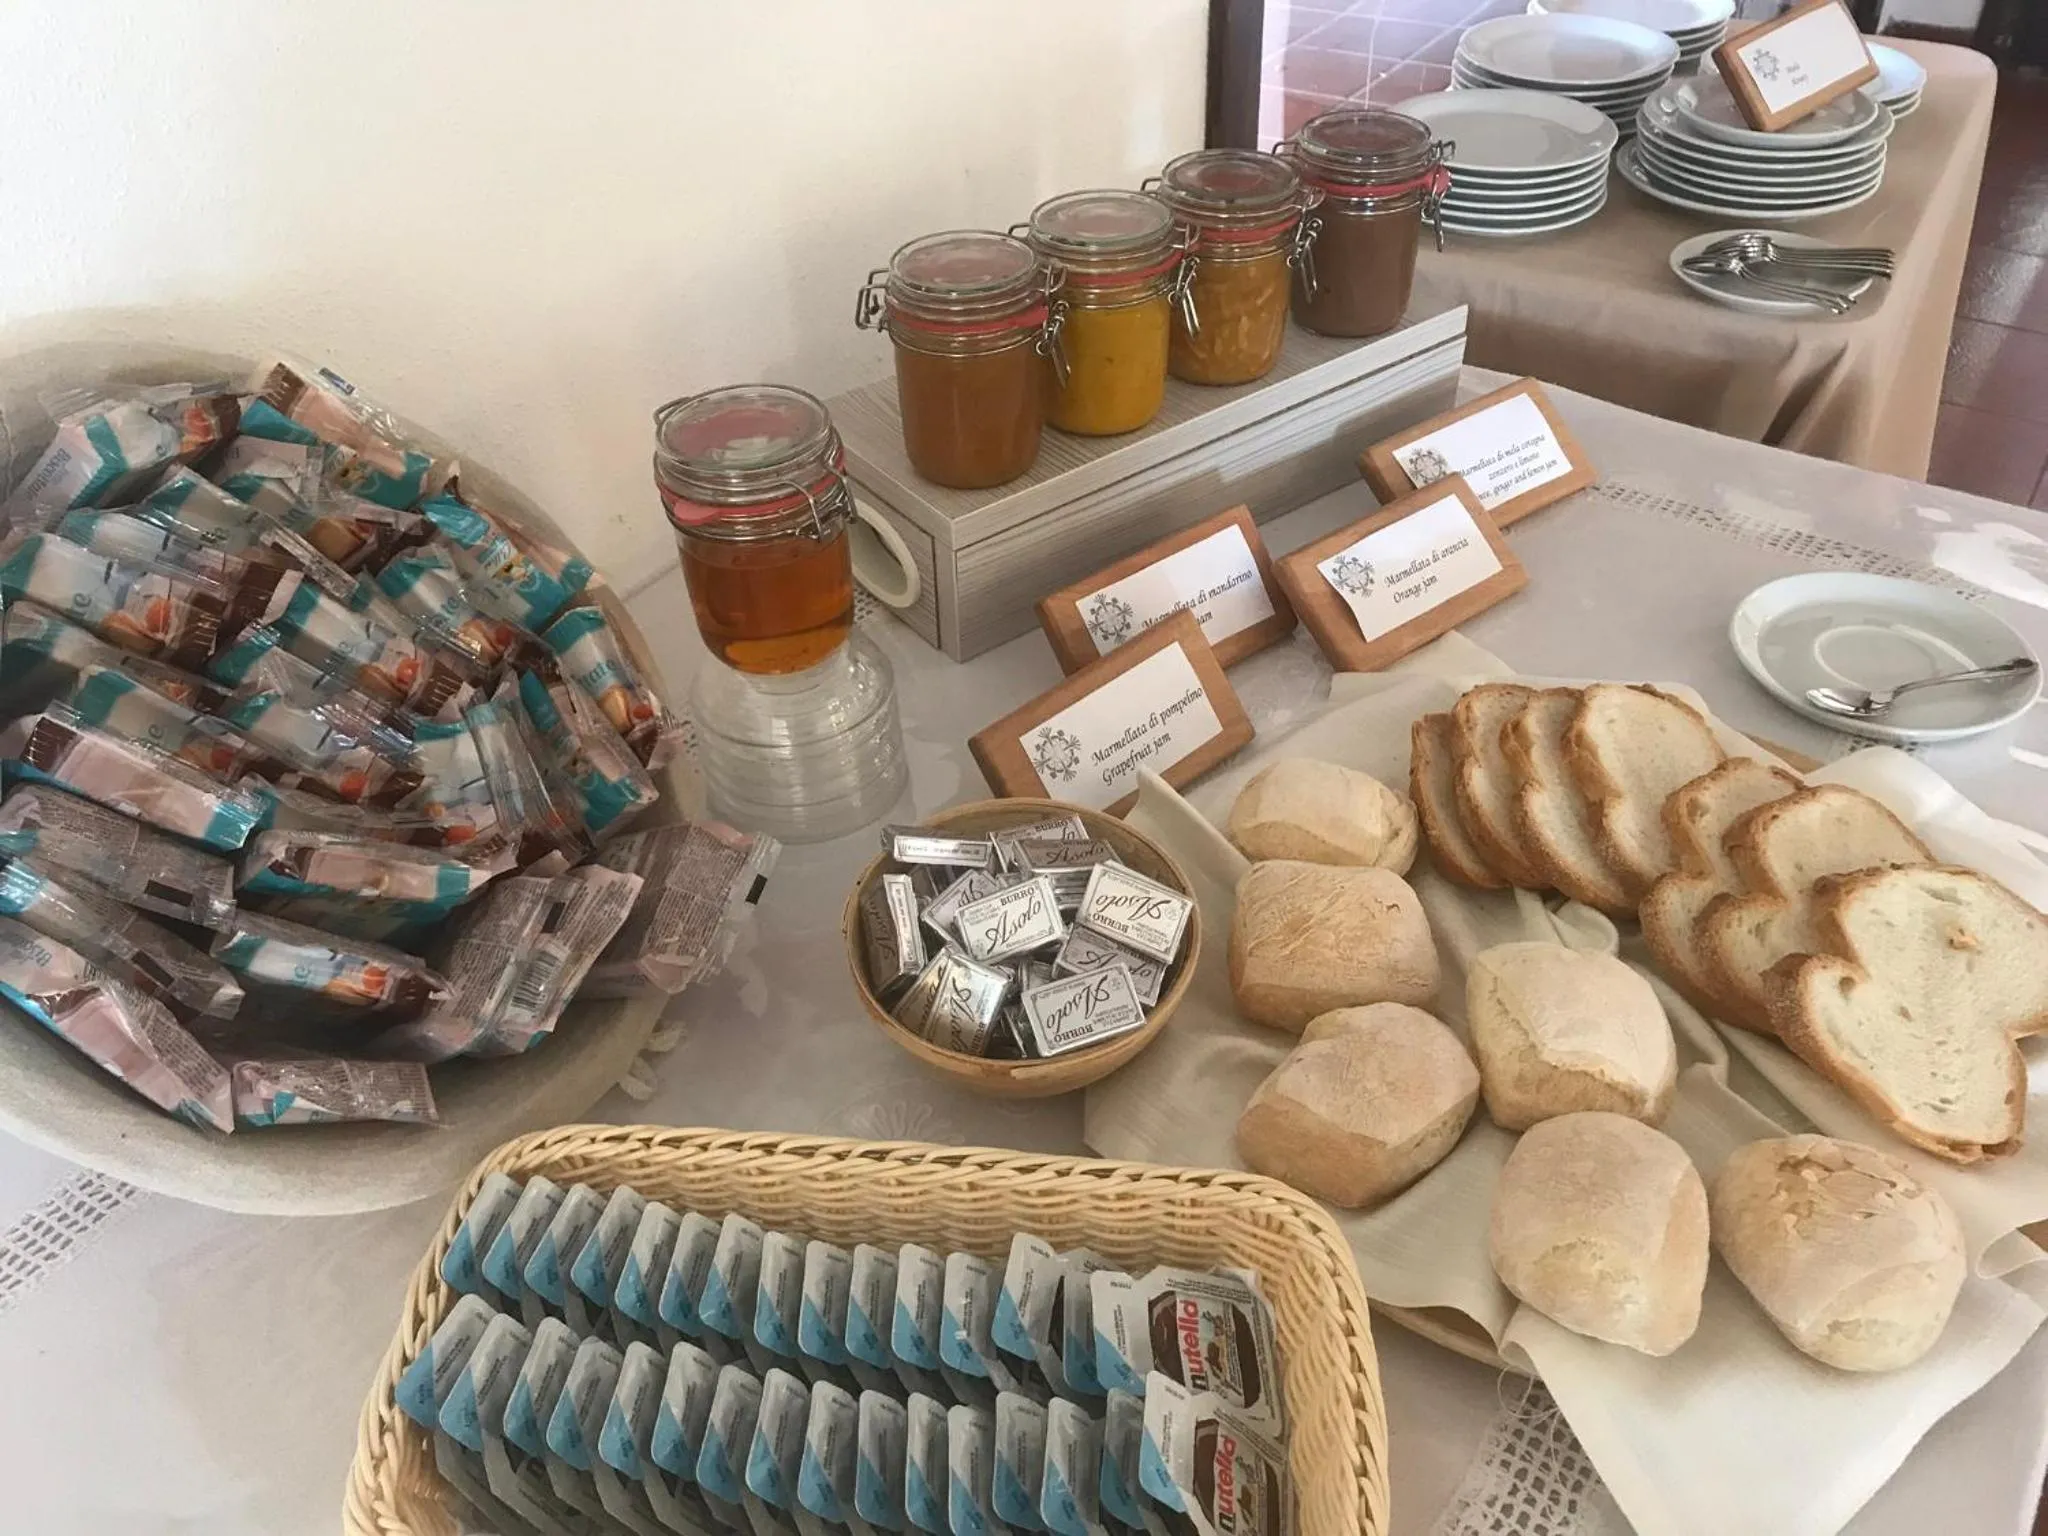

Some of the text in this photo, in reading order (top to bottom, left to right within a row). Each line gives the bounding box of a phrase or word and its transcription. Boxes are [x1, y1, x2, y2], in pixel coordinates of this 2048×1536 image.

[1514, 468, 1527, 484] and
[1384, 538, 1469, 588] Marmellata di arancia
[1198, 589, 1207, 604] di
[1208, 569, 1253, 599] mandarino
[1393, 574, 1438, 604] Orange jam
[1091, 687, 1203, 766] Marmellata di pompelmo
[1102, 732, 1171, 786] Grapefruit jam
[1000, 886, 1035, 906] BURRO
[1096, 894, 1172, 921] Asolo
[985, 896, 1042, 955] Asolo
[1092, 912, 1129, 934] BURRO
[1046, 973, 1110, 1034] Asolo
[1053, 1023, 1095, 1043] BURRO
[1177, 1299, 1210, 1391] nutella
[1215, 1436, 1237, 1534] nutella
